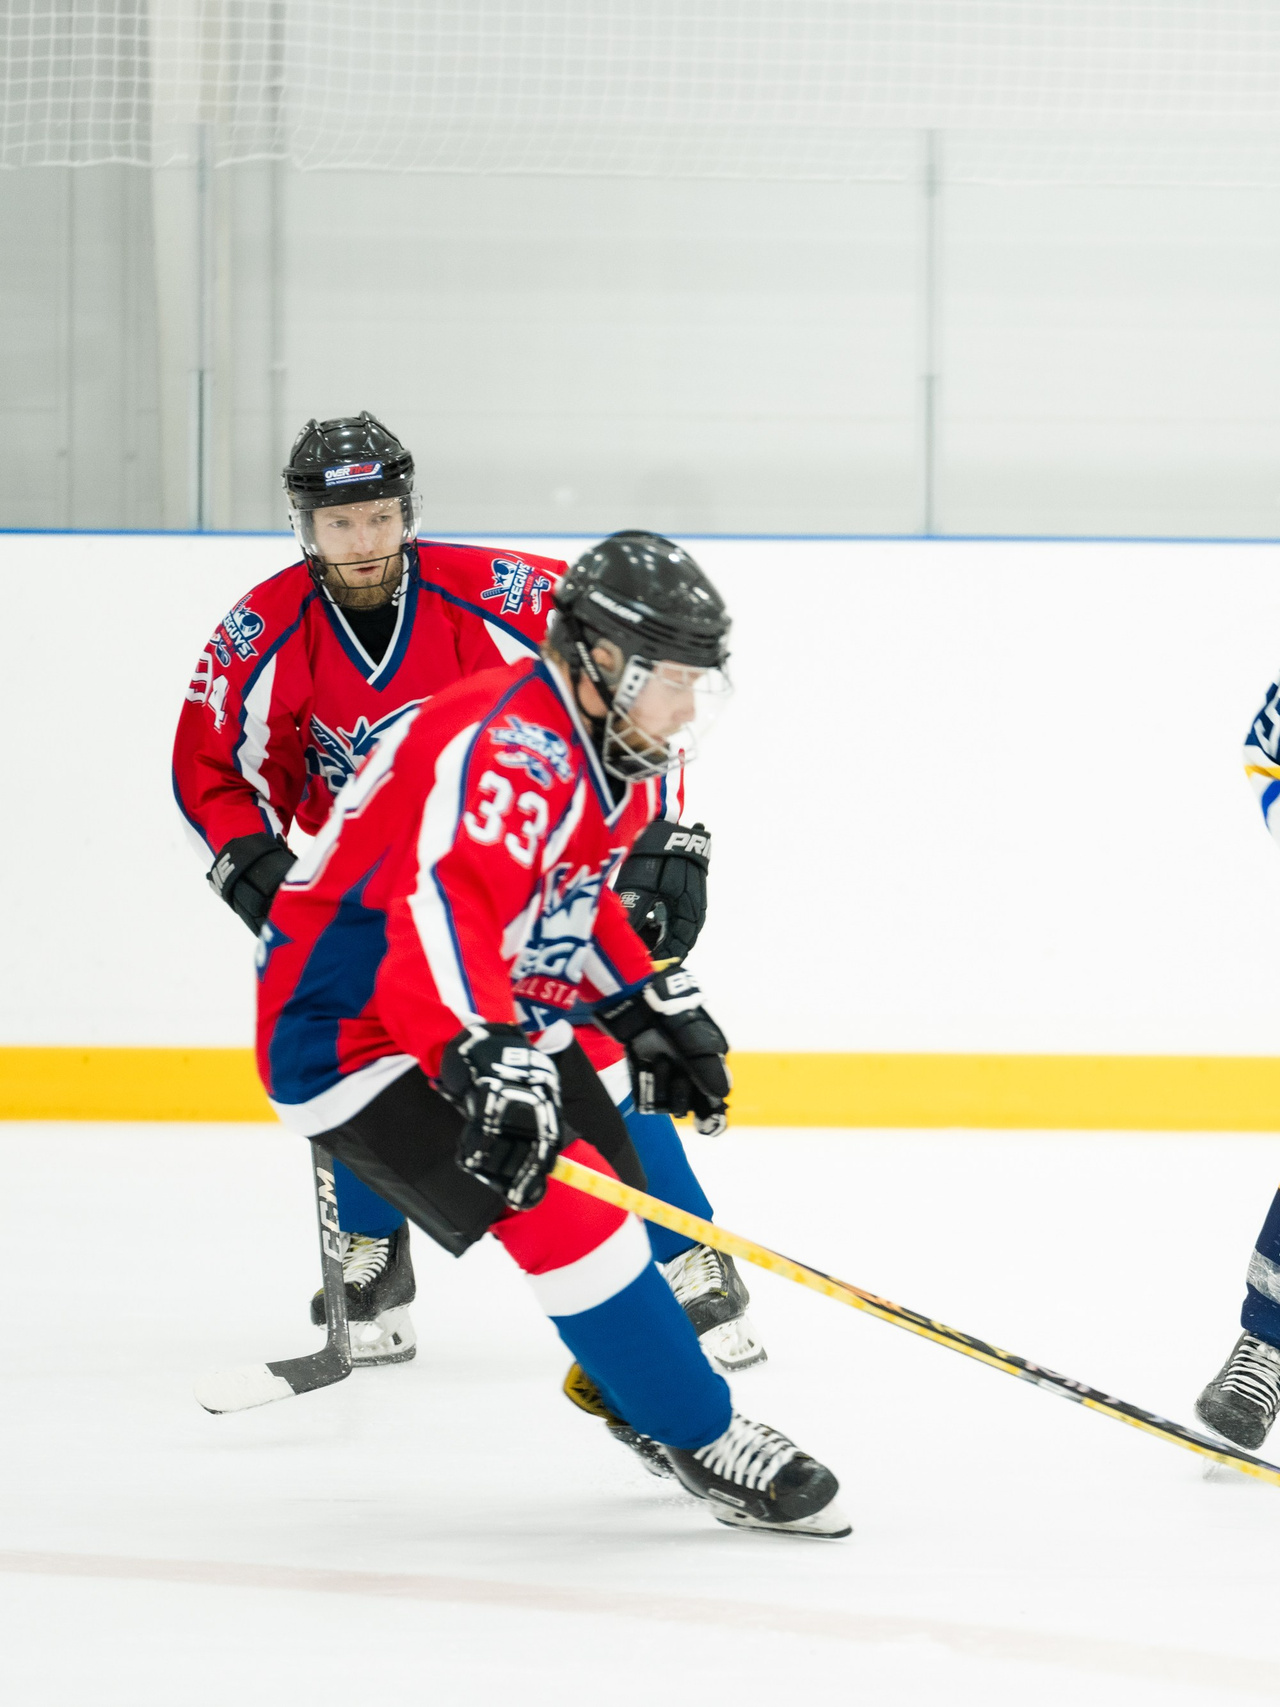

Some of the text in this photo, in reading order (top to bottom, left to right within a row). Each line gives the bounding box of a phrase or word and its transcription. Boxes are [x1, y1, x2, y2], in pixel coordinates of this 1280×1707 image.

[325, 464, 374, 479] OVERTIME
[506, 563, 532, 609] ICEGUYS
[463, 770, 549, 868] 33
[316, 1166, 343, 1263] CCM
